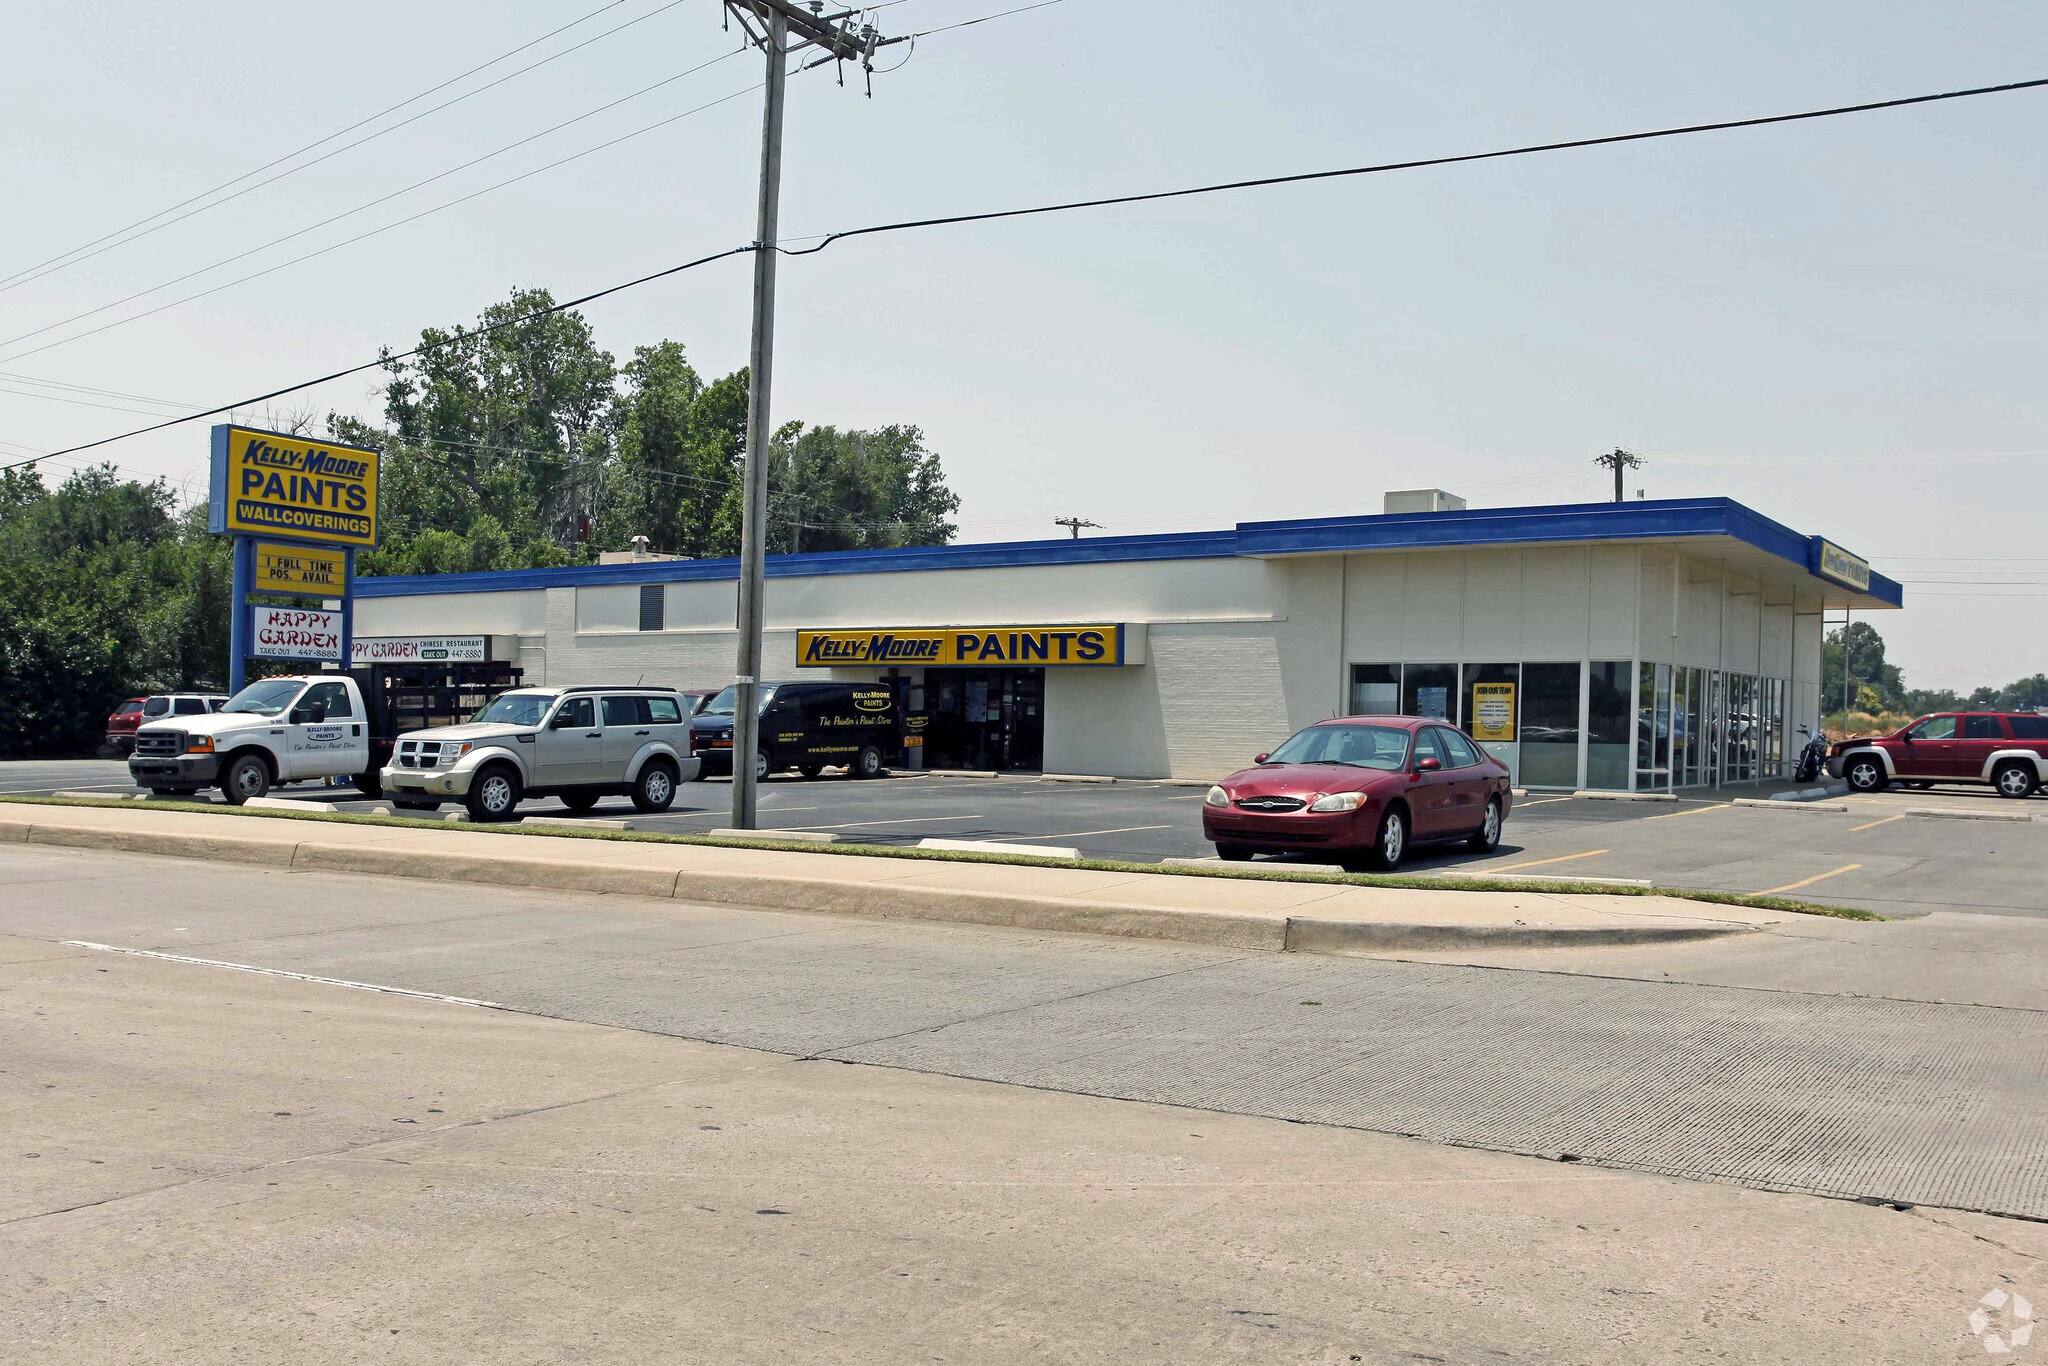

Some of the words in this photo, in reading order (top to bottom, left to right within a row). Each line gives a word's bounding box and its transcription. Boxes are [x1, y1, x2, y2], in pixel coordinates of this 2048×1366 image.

[242, 439, 369, 479] KELLY-MOORE
[242, 468, 367, 511] PAINTS
[239, 504, 370, 534] WALLCOVERINGS
[278, 558, 301, 569] FULL
[309, 561, 334, 572] TIME
[270, 569, 292, 580] POS.
[302, 571, 334, 583] AVAIL.
[268, 610, 331, 629] HAPPY
[259, 628, 338, 648] GARDEN
[420, 640, 443, 648] CHINESE
[259, 647, 276, 655] TAKE
[298, 649, 338, 658] 447-8880
[371, 642, 418, 658] GARDEN
[805, 634, 944, 661] KELLY-MOORE
[956, 631, 1105, 661] PAINTS
[451, 649, 482, 658] 447-8880
[852, 691, 890, 699] KELLY-MOORE
[1489, 687, 1499, 695] OUR
[1499, 687, 1511, 695] TEAM
[819, 716, 831, 726] The
[834, 715, 859, 725] Painter's
[860, 715, 875, 725] Paint
[876, 715, 892, 725] Store
[808, 746, 859, 754] www.kellymoore.com
